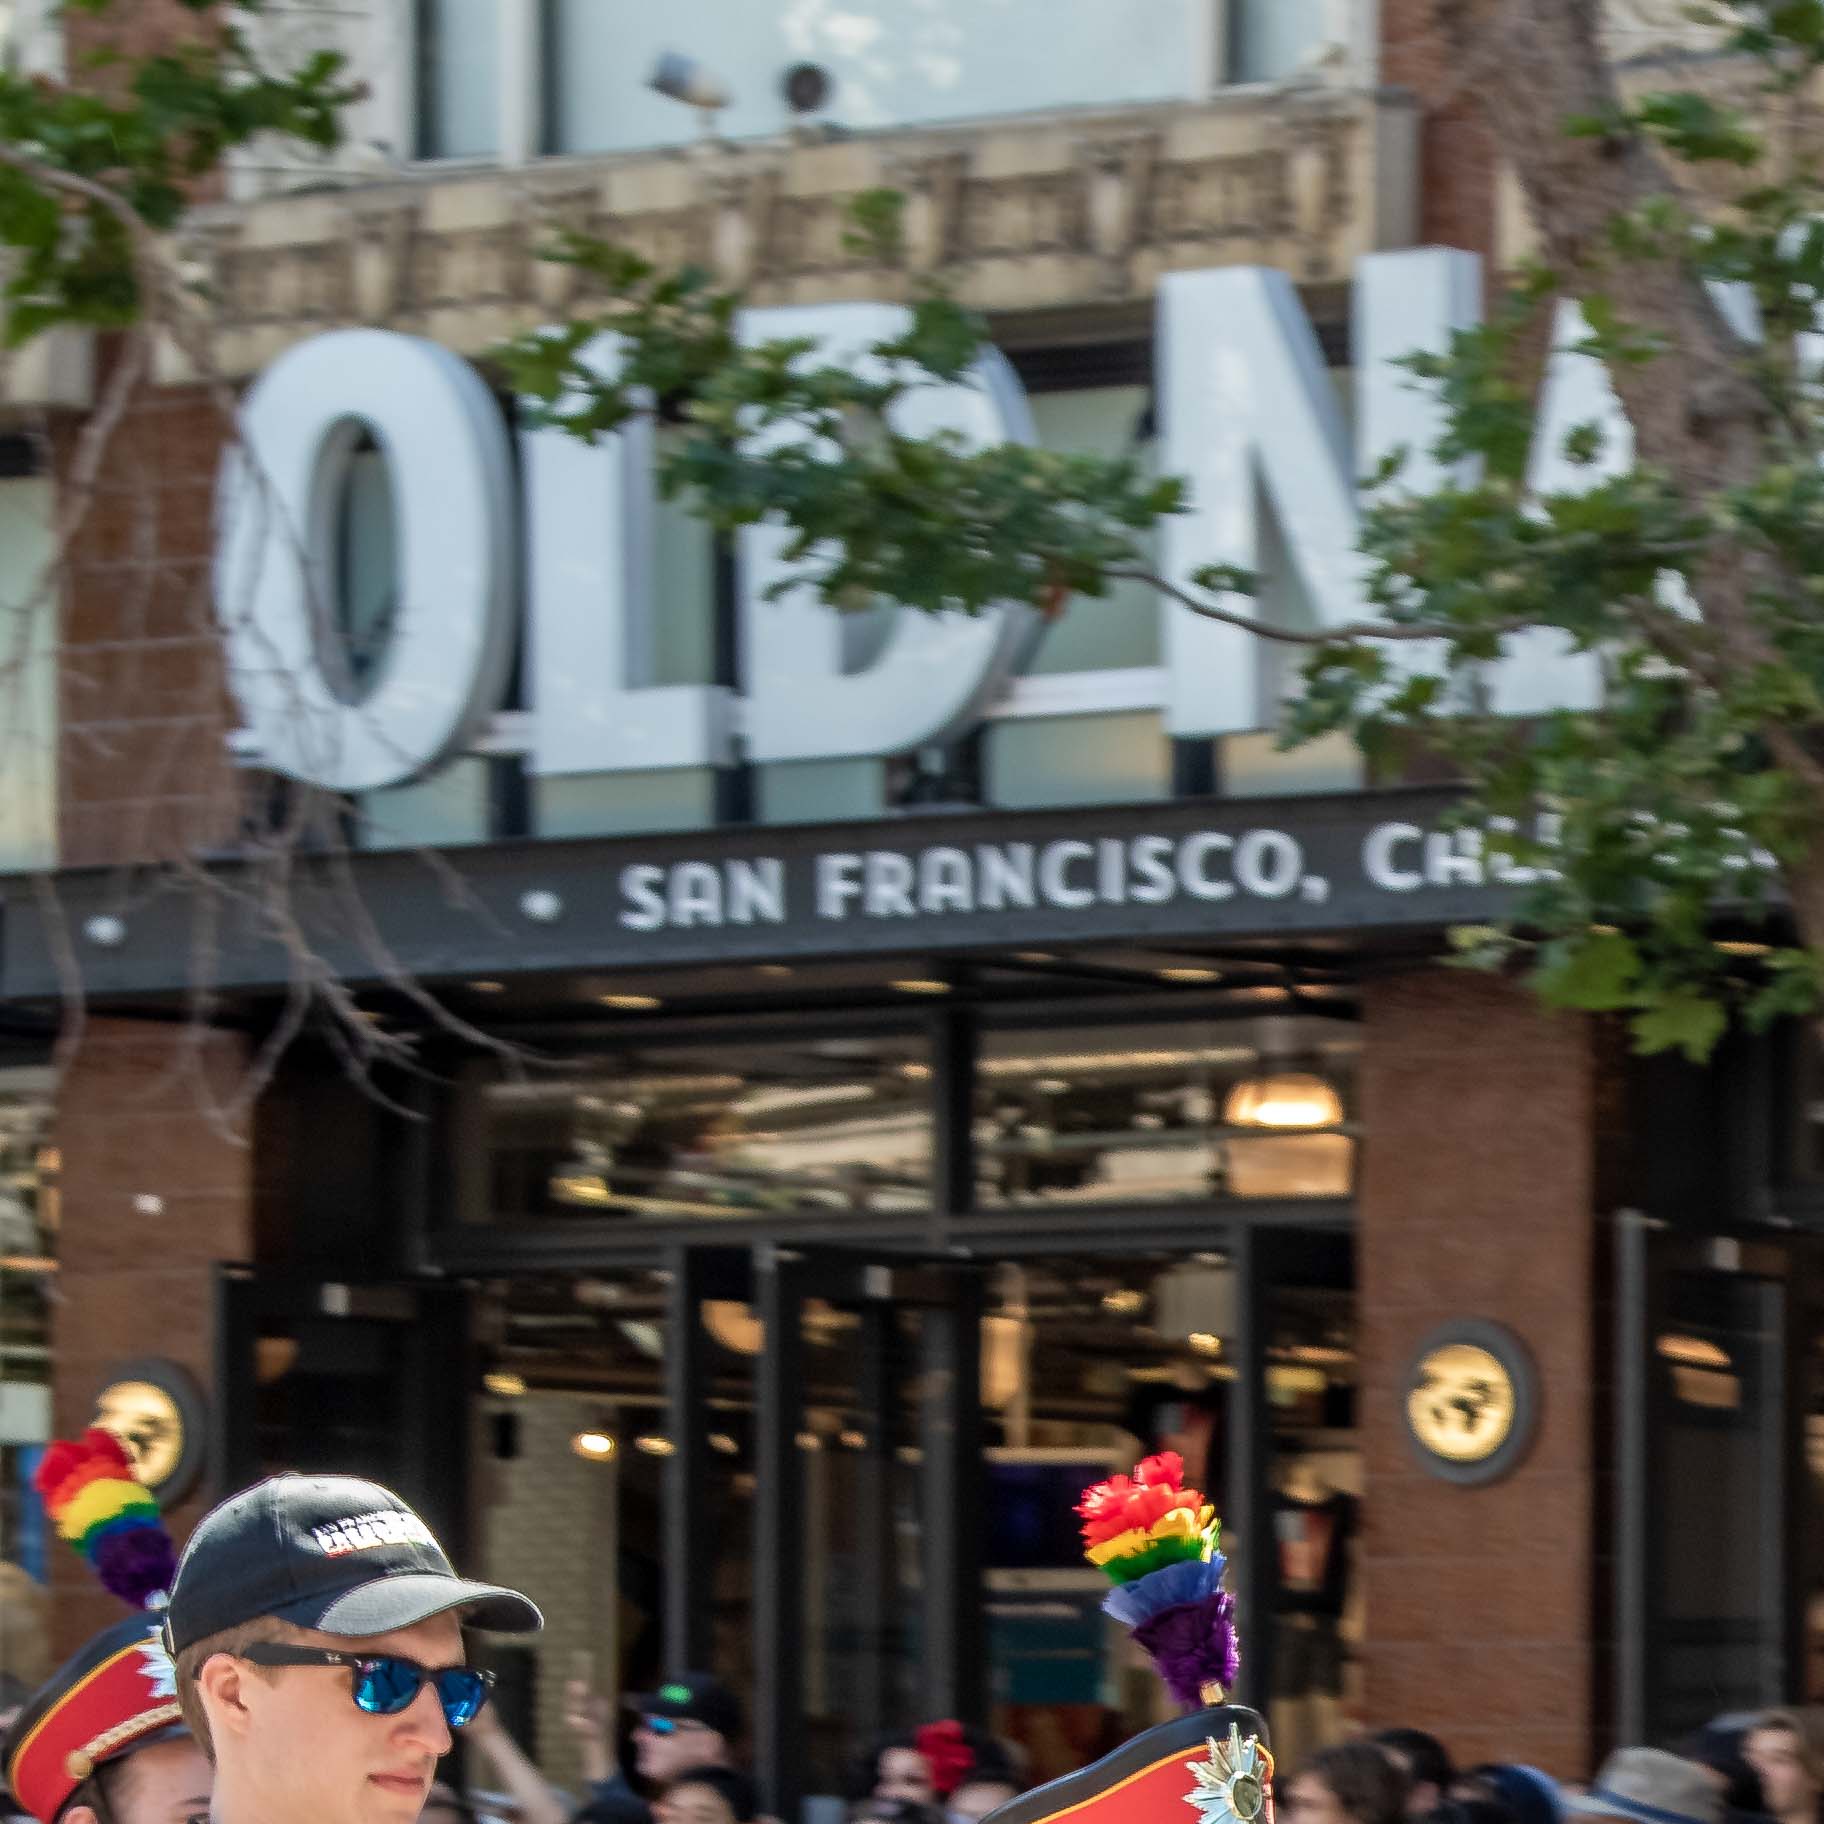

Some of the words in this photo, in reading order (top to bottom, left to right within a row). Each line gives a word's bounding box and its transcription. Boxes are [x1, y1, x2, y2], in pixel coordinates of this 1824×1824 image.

[215, 302, 1032, 790] OLD
[618, 858, 787, 931] SAN
[815, 828, 1330, 920] FRANCISCO,
